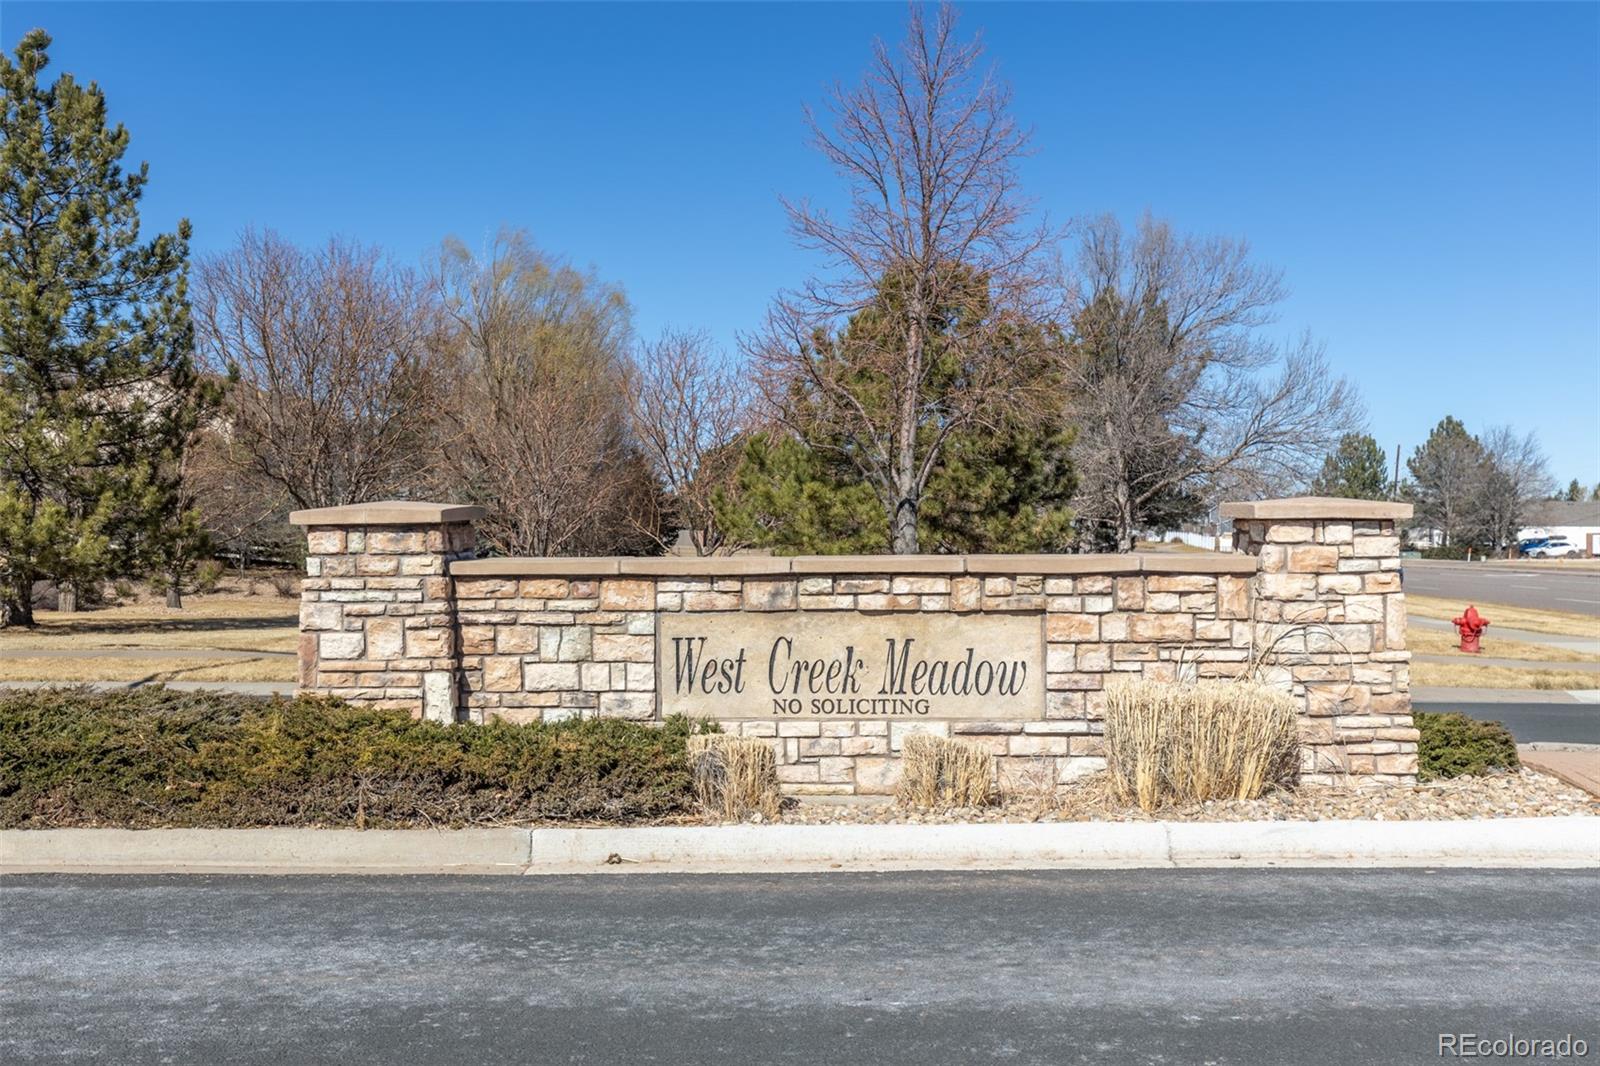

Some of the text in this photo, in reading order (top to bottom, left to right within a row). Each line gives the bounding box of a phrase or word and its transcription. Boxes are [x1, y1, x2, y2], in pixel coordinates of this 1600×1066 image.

[671, 636, 1027, 696] West Creek Meadow
[772, 699, 931, 716] NO SOLICITING
